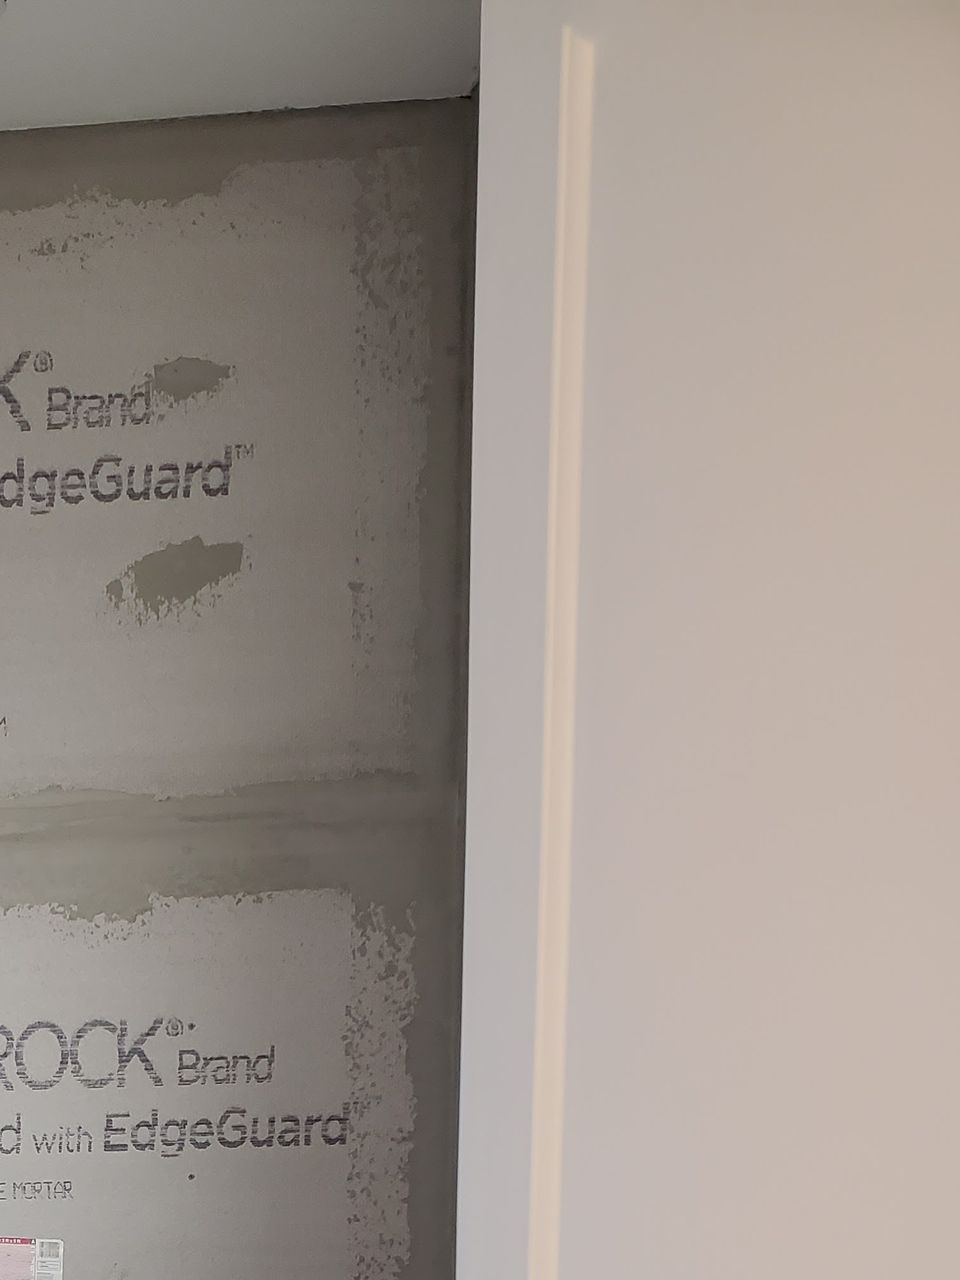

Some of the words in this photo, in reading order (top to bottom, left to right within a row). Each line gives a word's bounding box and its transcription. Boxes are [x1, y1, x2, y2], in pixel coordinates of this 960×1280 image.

[176, 1044, 275, 1086] Brand
[31, 1126, 93, 1153] with
[12, 1181, 73, 1199] MORTAR
